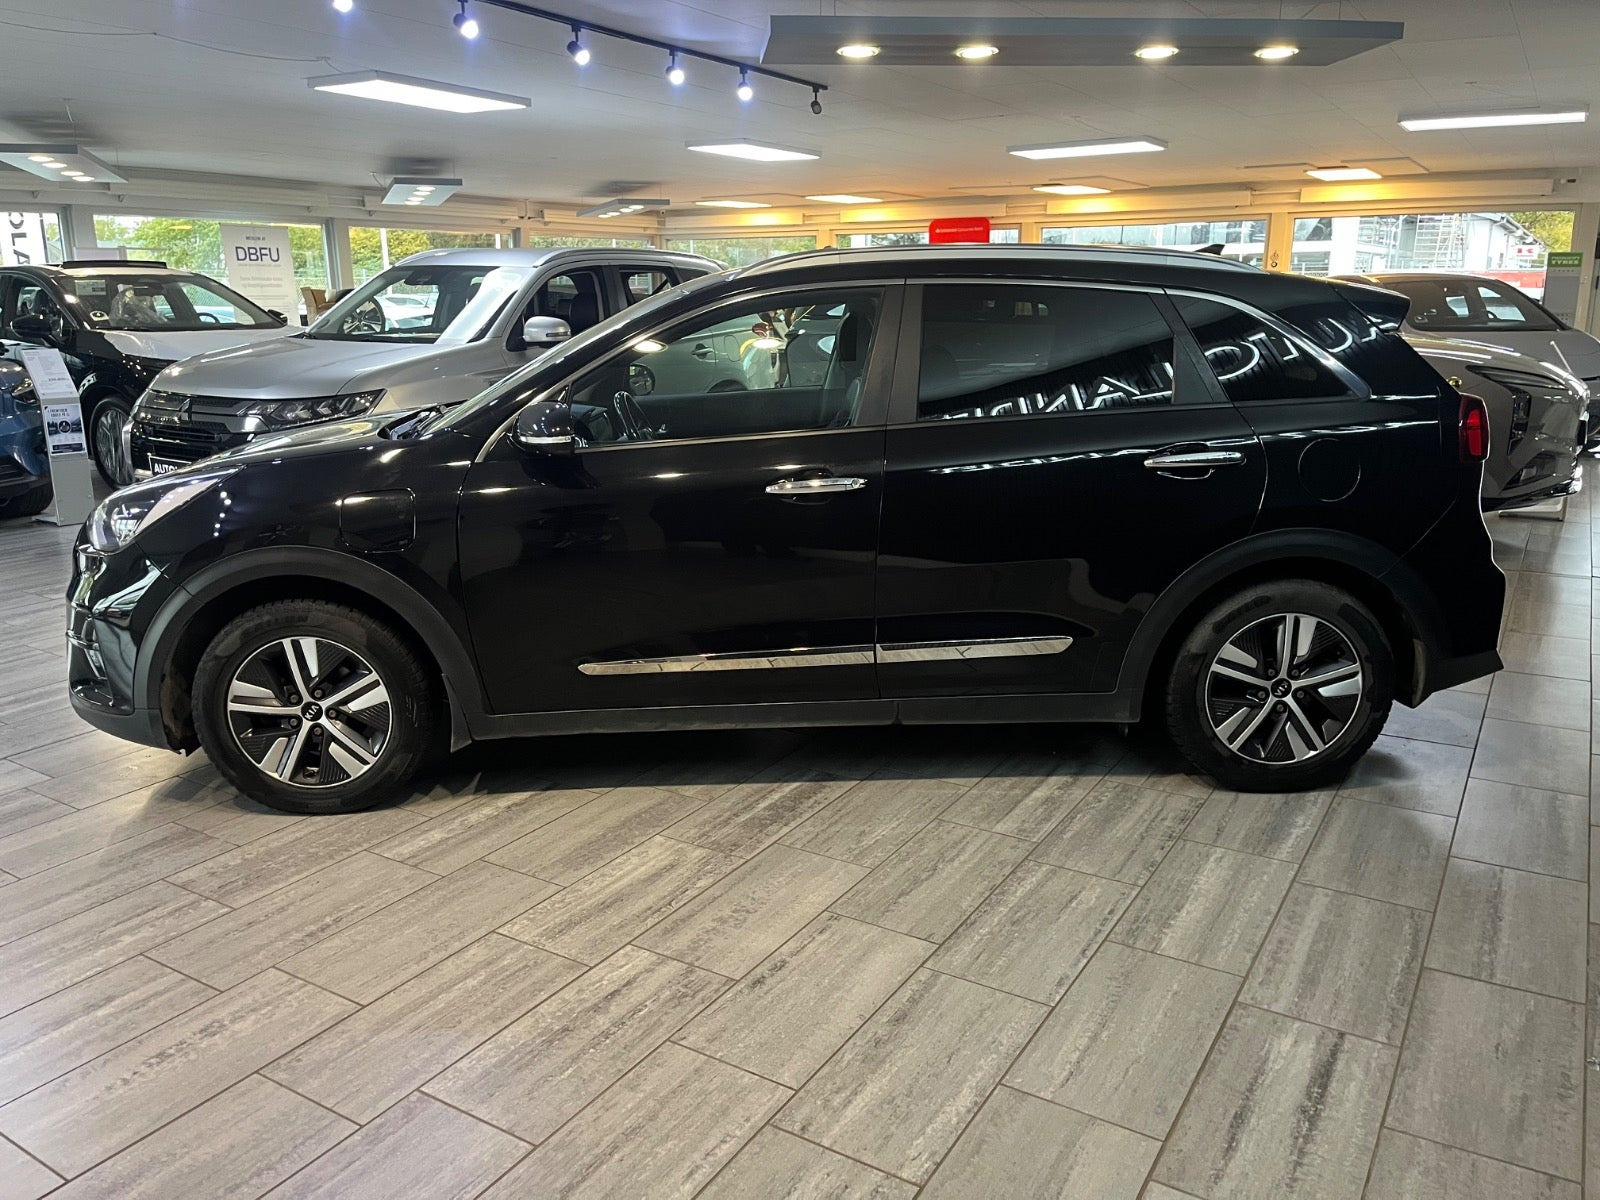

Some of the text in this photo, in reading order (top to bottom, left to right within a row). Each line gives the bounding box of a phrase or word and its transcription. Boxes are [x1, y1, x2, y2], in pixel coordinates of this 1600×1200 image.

[235, 246, 281, 263] DBFU
[154, 462, 178, 474] AUTO
[304, 704, 320, 720] KIA
